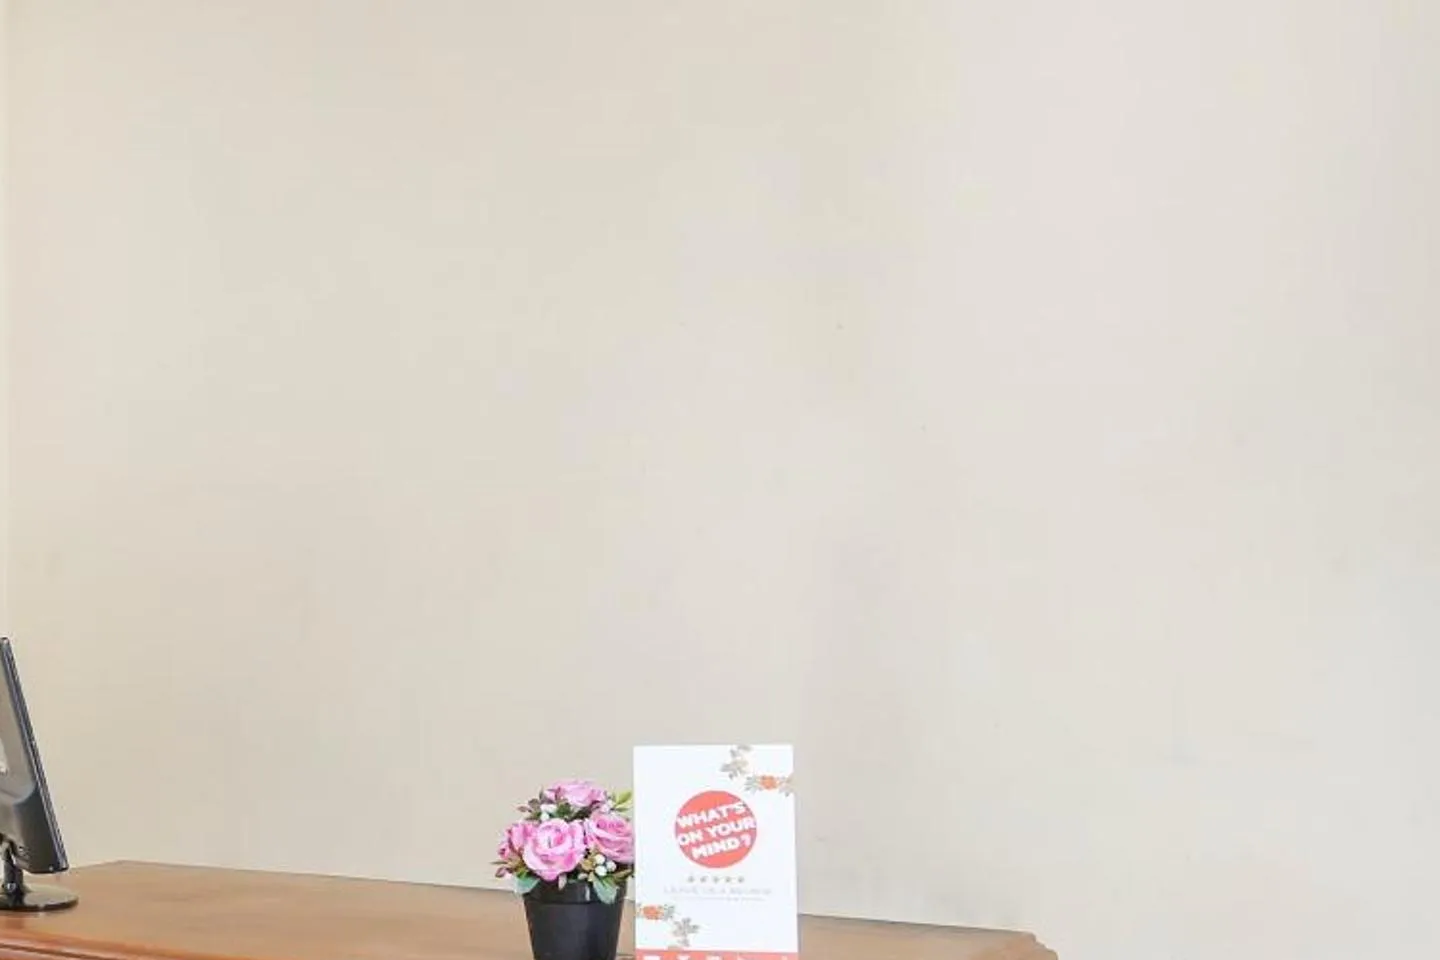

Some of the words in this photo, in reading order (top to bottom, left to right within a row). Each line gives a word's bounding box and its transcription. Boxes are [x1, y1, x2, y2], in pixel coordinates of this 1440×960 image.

[677, 802, 746, 827] WHAT'S
[678, 830, 703, 846] ON
[706, 816, 755, 837] YOUR
